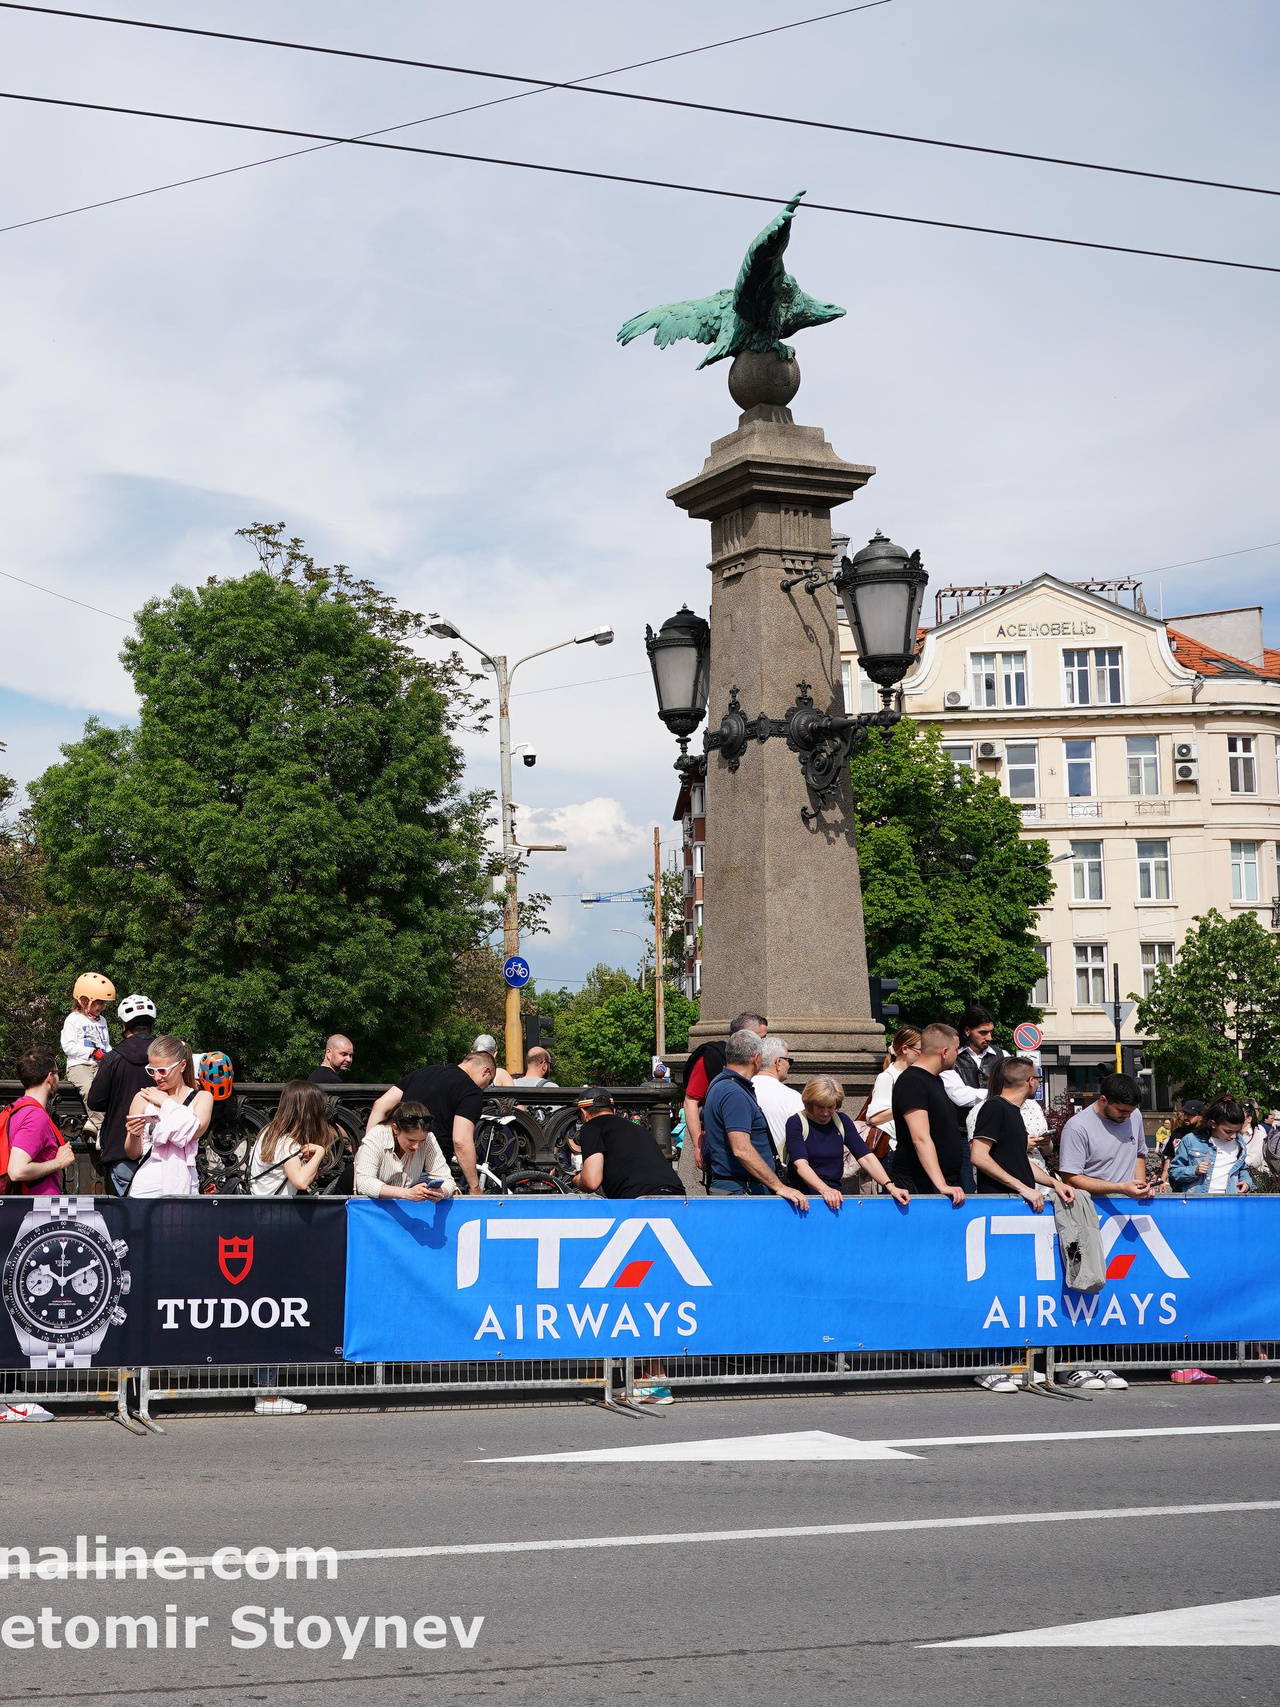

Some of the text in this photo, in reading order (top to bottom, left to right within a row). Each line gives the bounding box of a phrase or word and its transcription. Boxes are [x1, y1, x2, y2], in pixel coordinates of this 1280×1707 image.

[996, 621, 1096, 638] АСЕНОВЕЦЪ
[457, 1217, 713, 1290] ITA
[158, 1297, 310, 1330] TUDOR
[473, 1301, 698, 1341] AIRWAYS
[982, 1292, 1177, 1329] AIRWAYS
